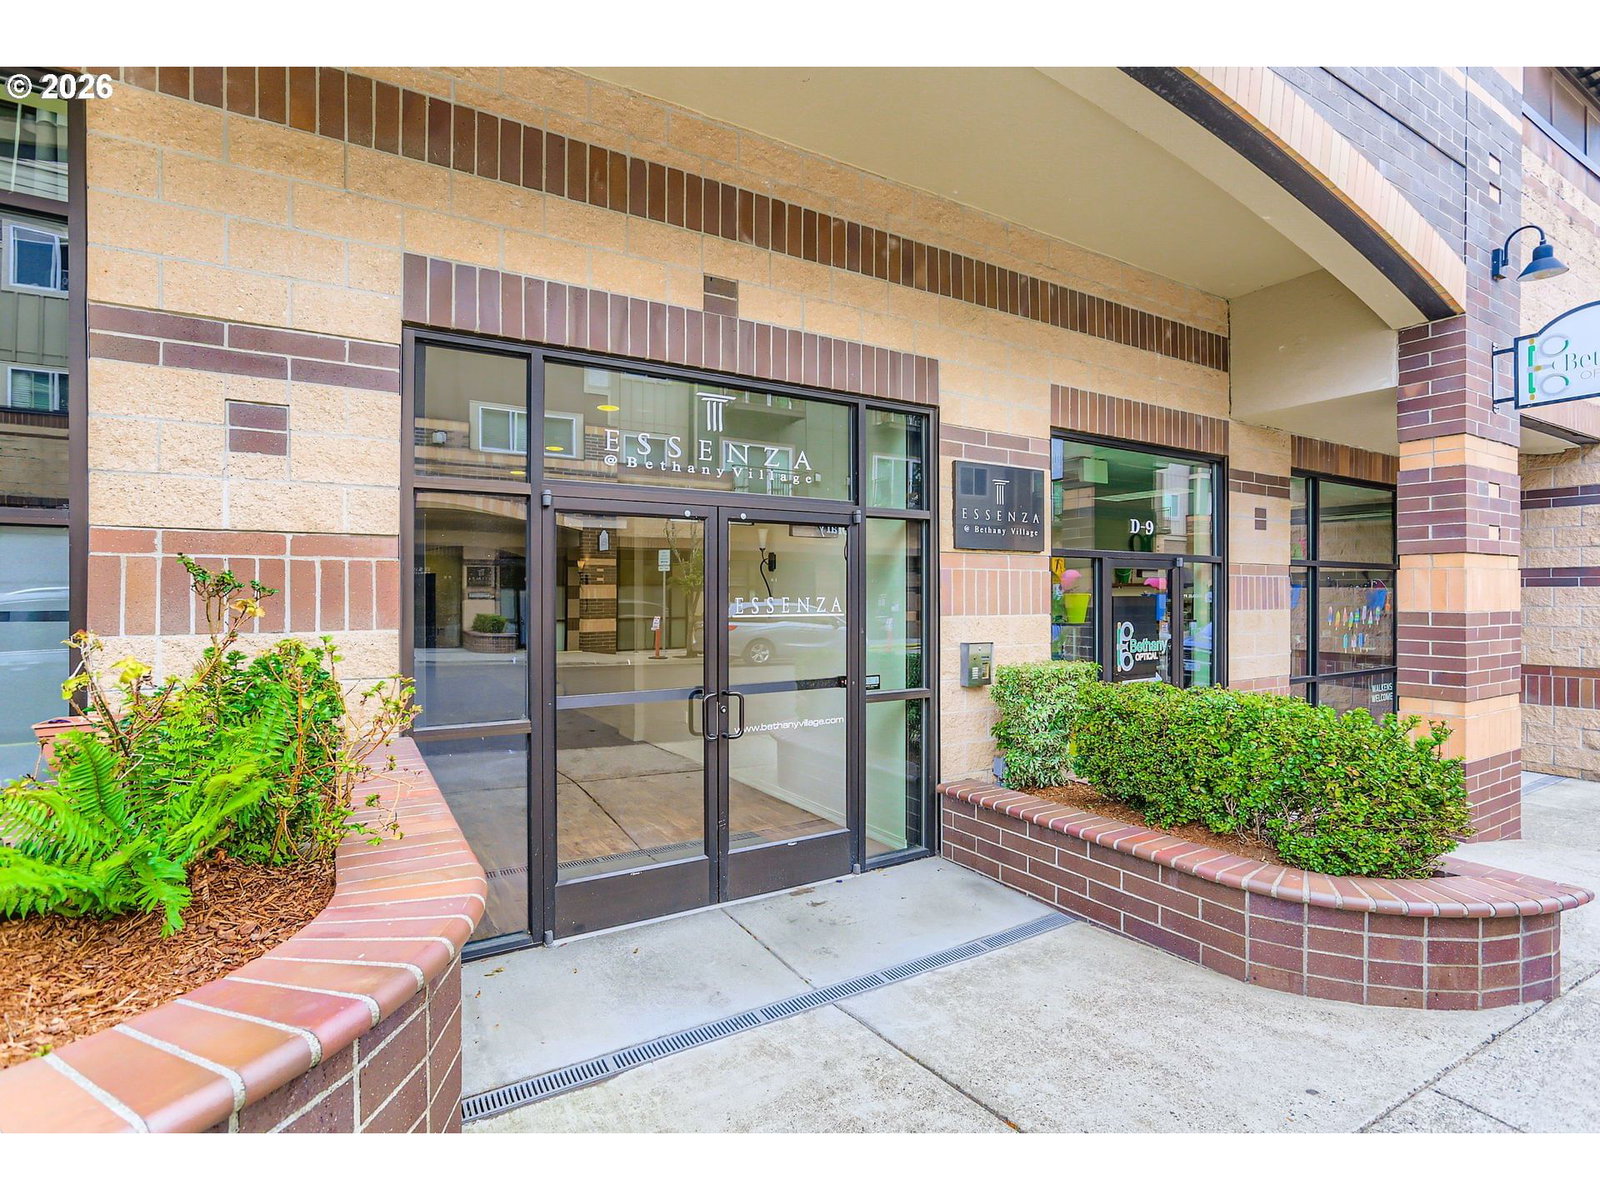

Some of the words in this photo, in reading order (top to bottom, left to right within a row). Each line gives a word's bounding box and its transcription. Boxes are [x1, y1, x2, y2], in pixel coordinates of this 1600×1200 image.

[604, 429, 812, 471] ESSENZA
[962, 507, 1040, 524] ESSENZA
[974, 525, 1006, 536] Bethany
[1010, 527, 1039, 538] Village
[1129, 518, 1154, 536] D-9
[735, 596, 842, 615] ESSENZA
[1129, 638, 1168, 655] Bethany
[1135, 652, 1159, 662] OPTICAL
[734, 716, 845, 734] www.bethanyvillage.com
